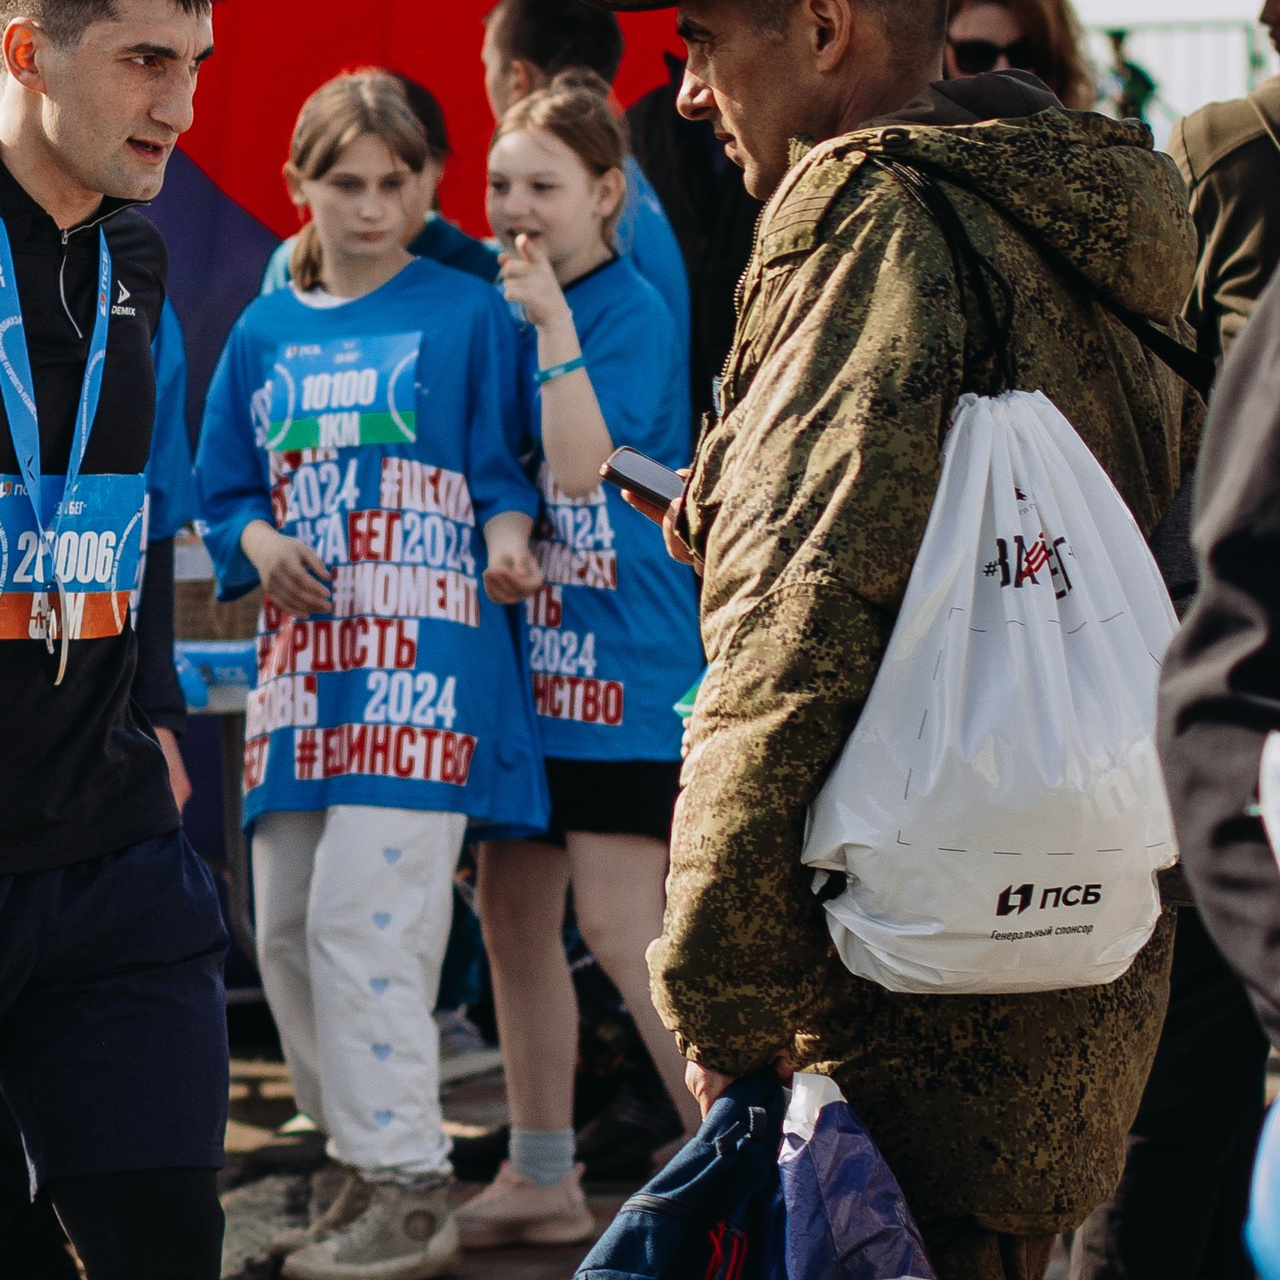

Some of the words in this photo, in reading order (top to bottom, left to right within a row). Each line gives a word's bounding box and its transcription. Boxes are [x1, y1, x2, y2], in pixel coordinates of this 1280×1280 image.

[111, 305, 136, 317] DEMIX
[301, 367, 379, 412] 10100
[530, 627, 597, 676] 2024
[363, 672, 458, 727] 2024
[1039, 883, 1103, 910] ПСБ
[990, 925, 1053, 942] Генеральный
[1055, 924, 1094, 936] спонсор
